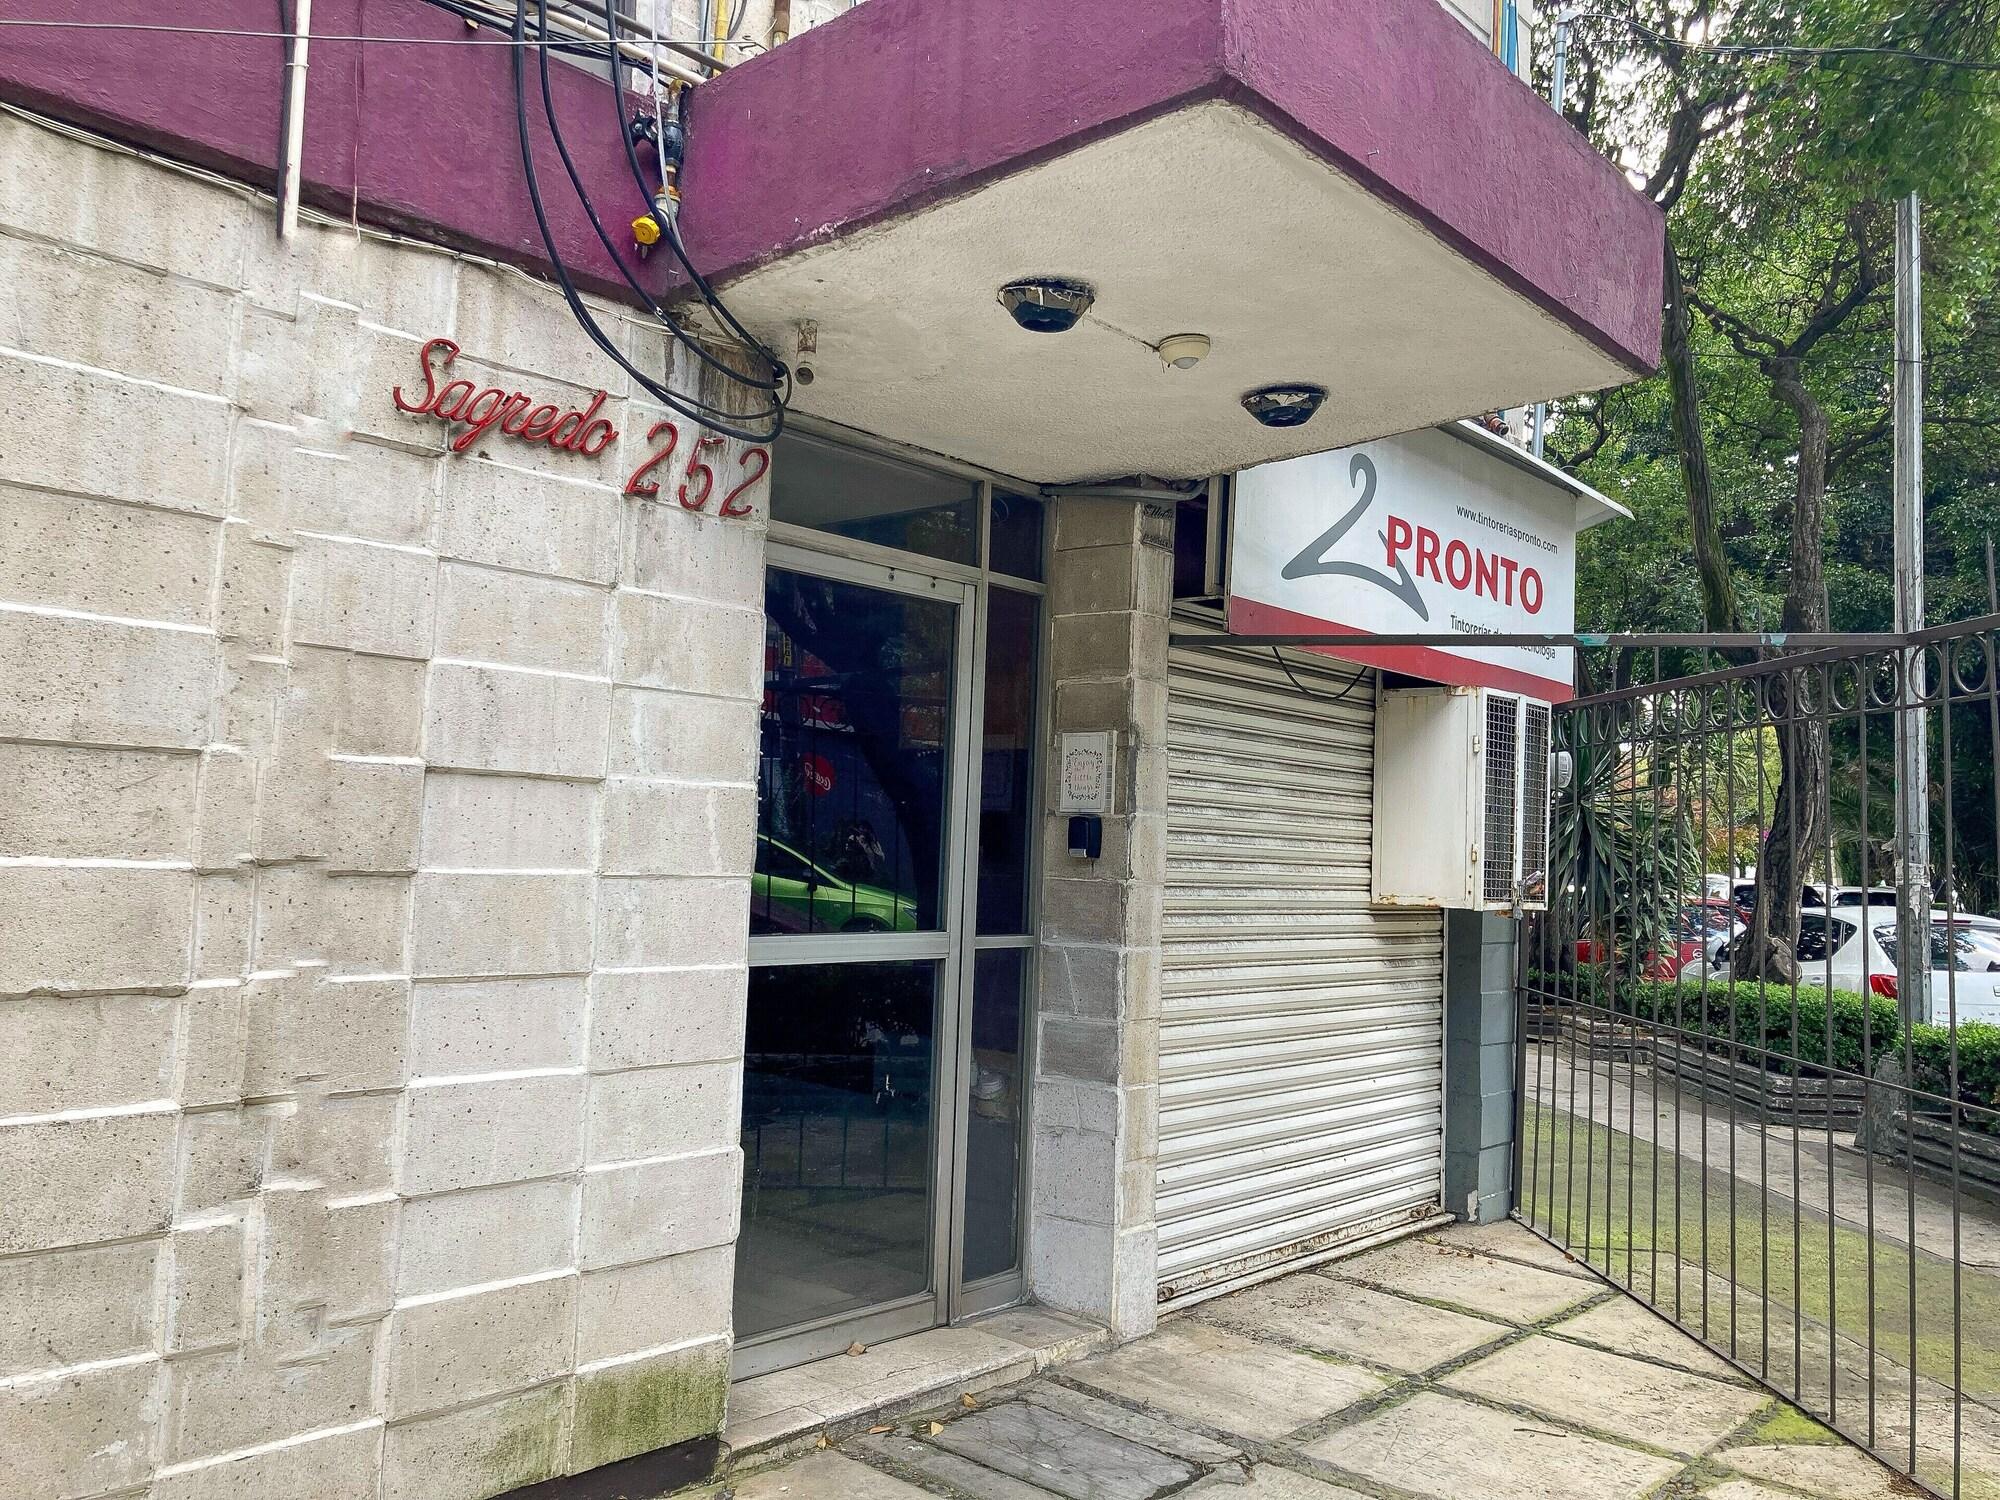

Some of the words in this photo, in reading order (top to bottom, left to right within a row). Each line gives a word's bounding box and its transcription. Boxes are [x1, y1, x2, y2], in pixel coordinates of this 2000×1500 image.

[393, 338, 618, 455] Sagredo
[624, 421, 770, 517] 252
[1386, 514, 1545, 615] PRONTO
[1456, 505, 1558, 555] www.tintoreriaspronto.com
